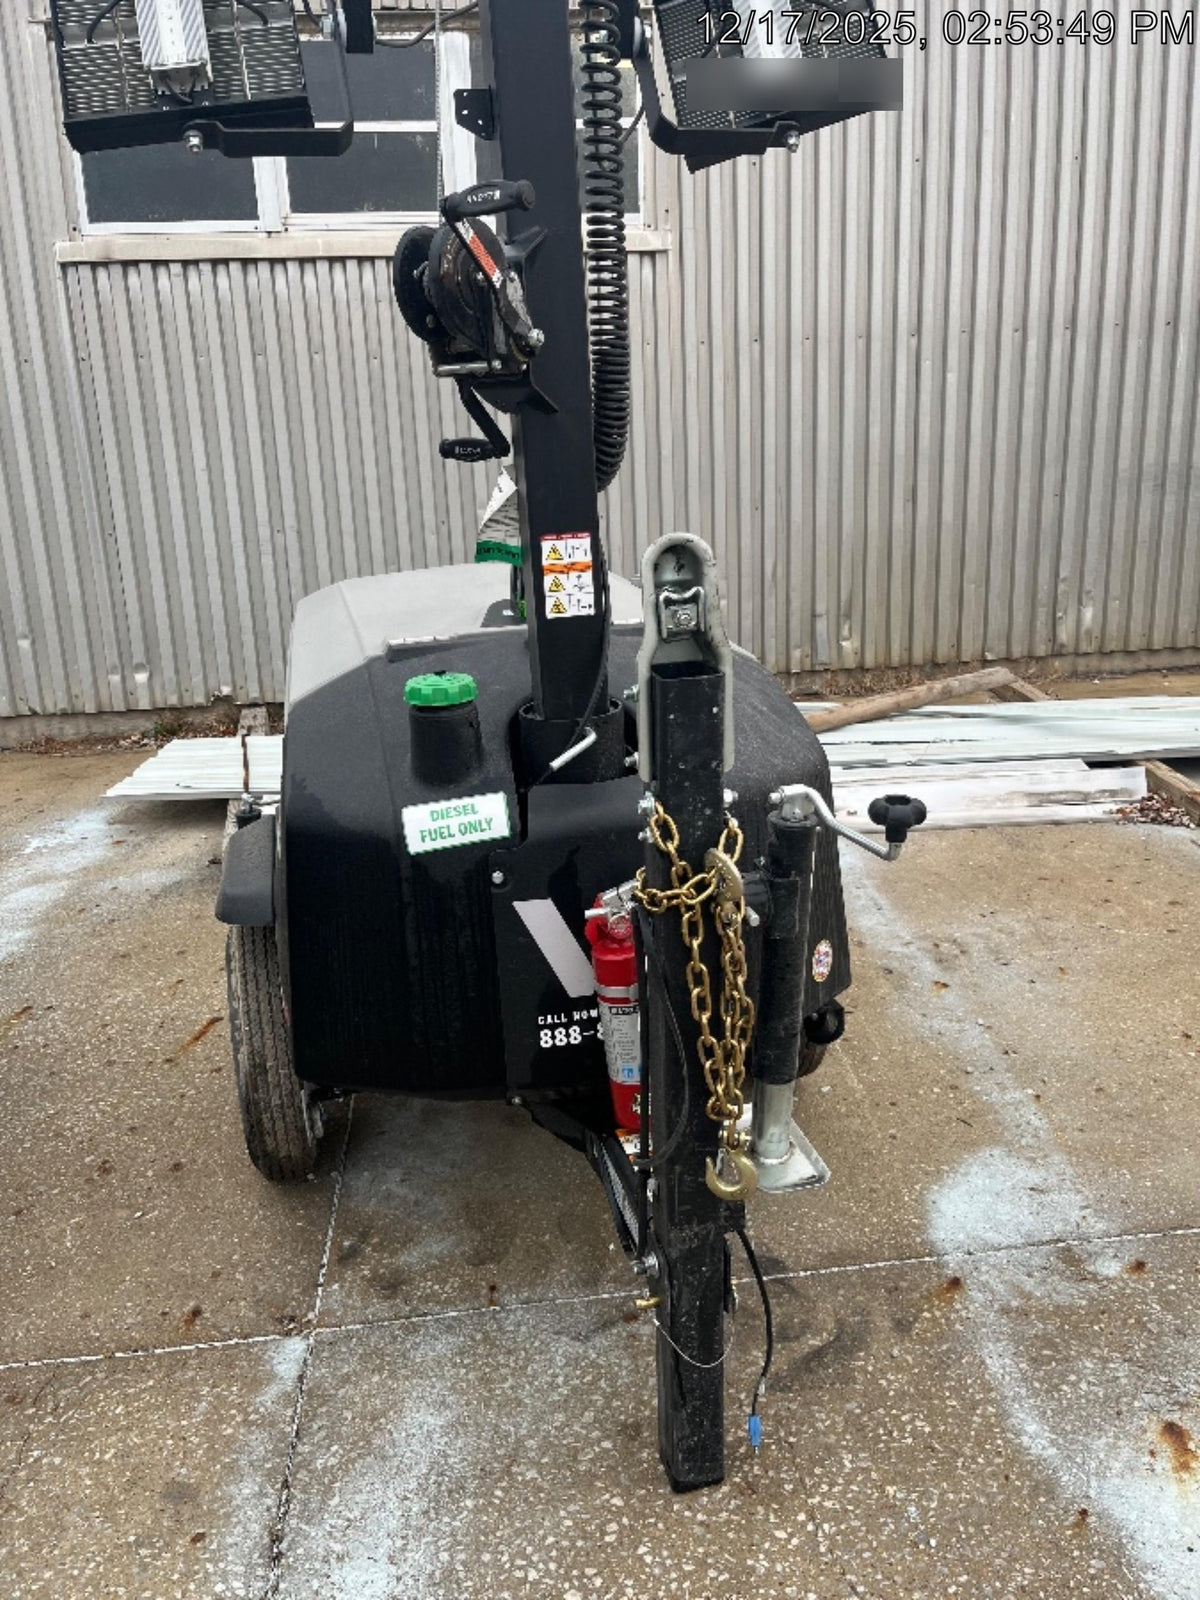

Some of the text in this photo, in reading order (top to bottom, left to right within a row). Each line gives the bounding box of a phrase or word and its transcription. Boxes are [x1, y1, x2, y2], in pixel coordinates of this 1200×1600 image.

[430, 803, 479, 822] DIESEL
[420, 817, 494, 843] FUEL ONLY
[538, 1012, 568, 1025] CALL
